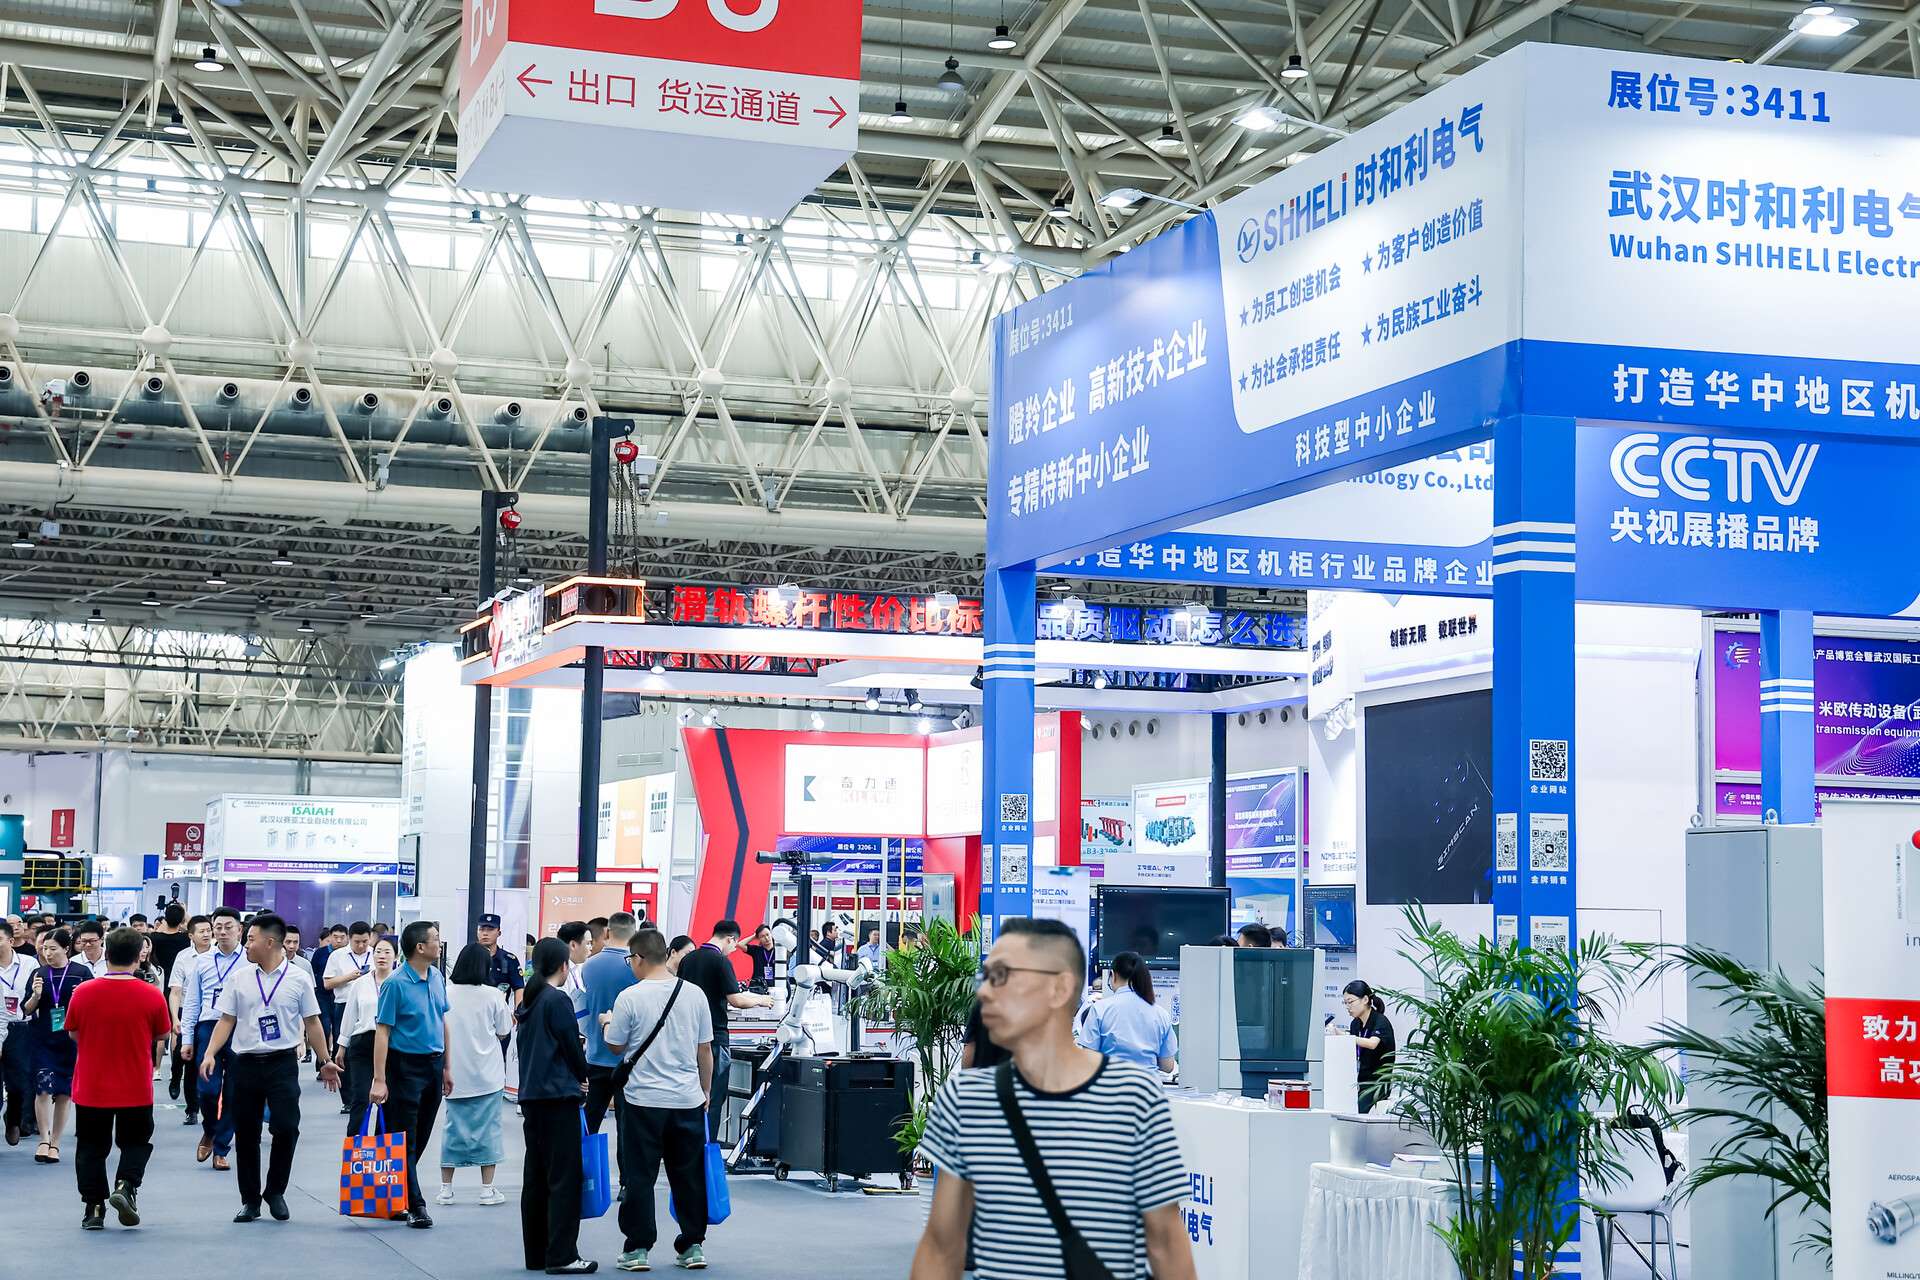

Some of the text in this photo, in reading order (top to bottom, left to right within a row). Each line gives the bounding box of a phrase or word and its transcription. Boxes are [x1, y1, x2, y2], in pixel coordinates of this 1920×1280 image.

[568, 69, 800, 126] 出口 货运通道
[1608, 70, 1831, 123] 展位号:3411
[1354, 103, 1484, 208] 时和利电气
[1377, 198, 1484, 271] 为客户创造价值
[1610, 233, 1708, 264] Wuhan
[1251, 262, 1342, 325] 为员工创造机会
[1376, 274, 1483, 344] 为民族工业奋斗
[1088, 319, 1208, 415] 高新技术企业
[1250, 330, 1342, 390] 为社会承担责任
[1295, 389, 1436, 468] 科技型中小企业
[1007, 425, 1150, 517] 专精特新中小企业
[1609, 433, 1820, 506] CCTV
[1610, 506, 1820, 554] 央视展播品牌
[1064, 541, 1494, 586] 造华中地区机柜行业品牌企业
[1036, 603, 1308, 647] 品质驱动怎么选
[1816, 724, 1881, 736] transmission
[291, 806, 335, 816] ISAIAH
[1530, 785, 1567, 794] 企业网站
[1530, 875, 1567, 885] 金牌销售
[1862, 1015, 1917, 1041] 致力
